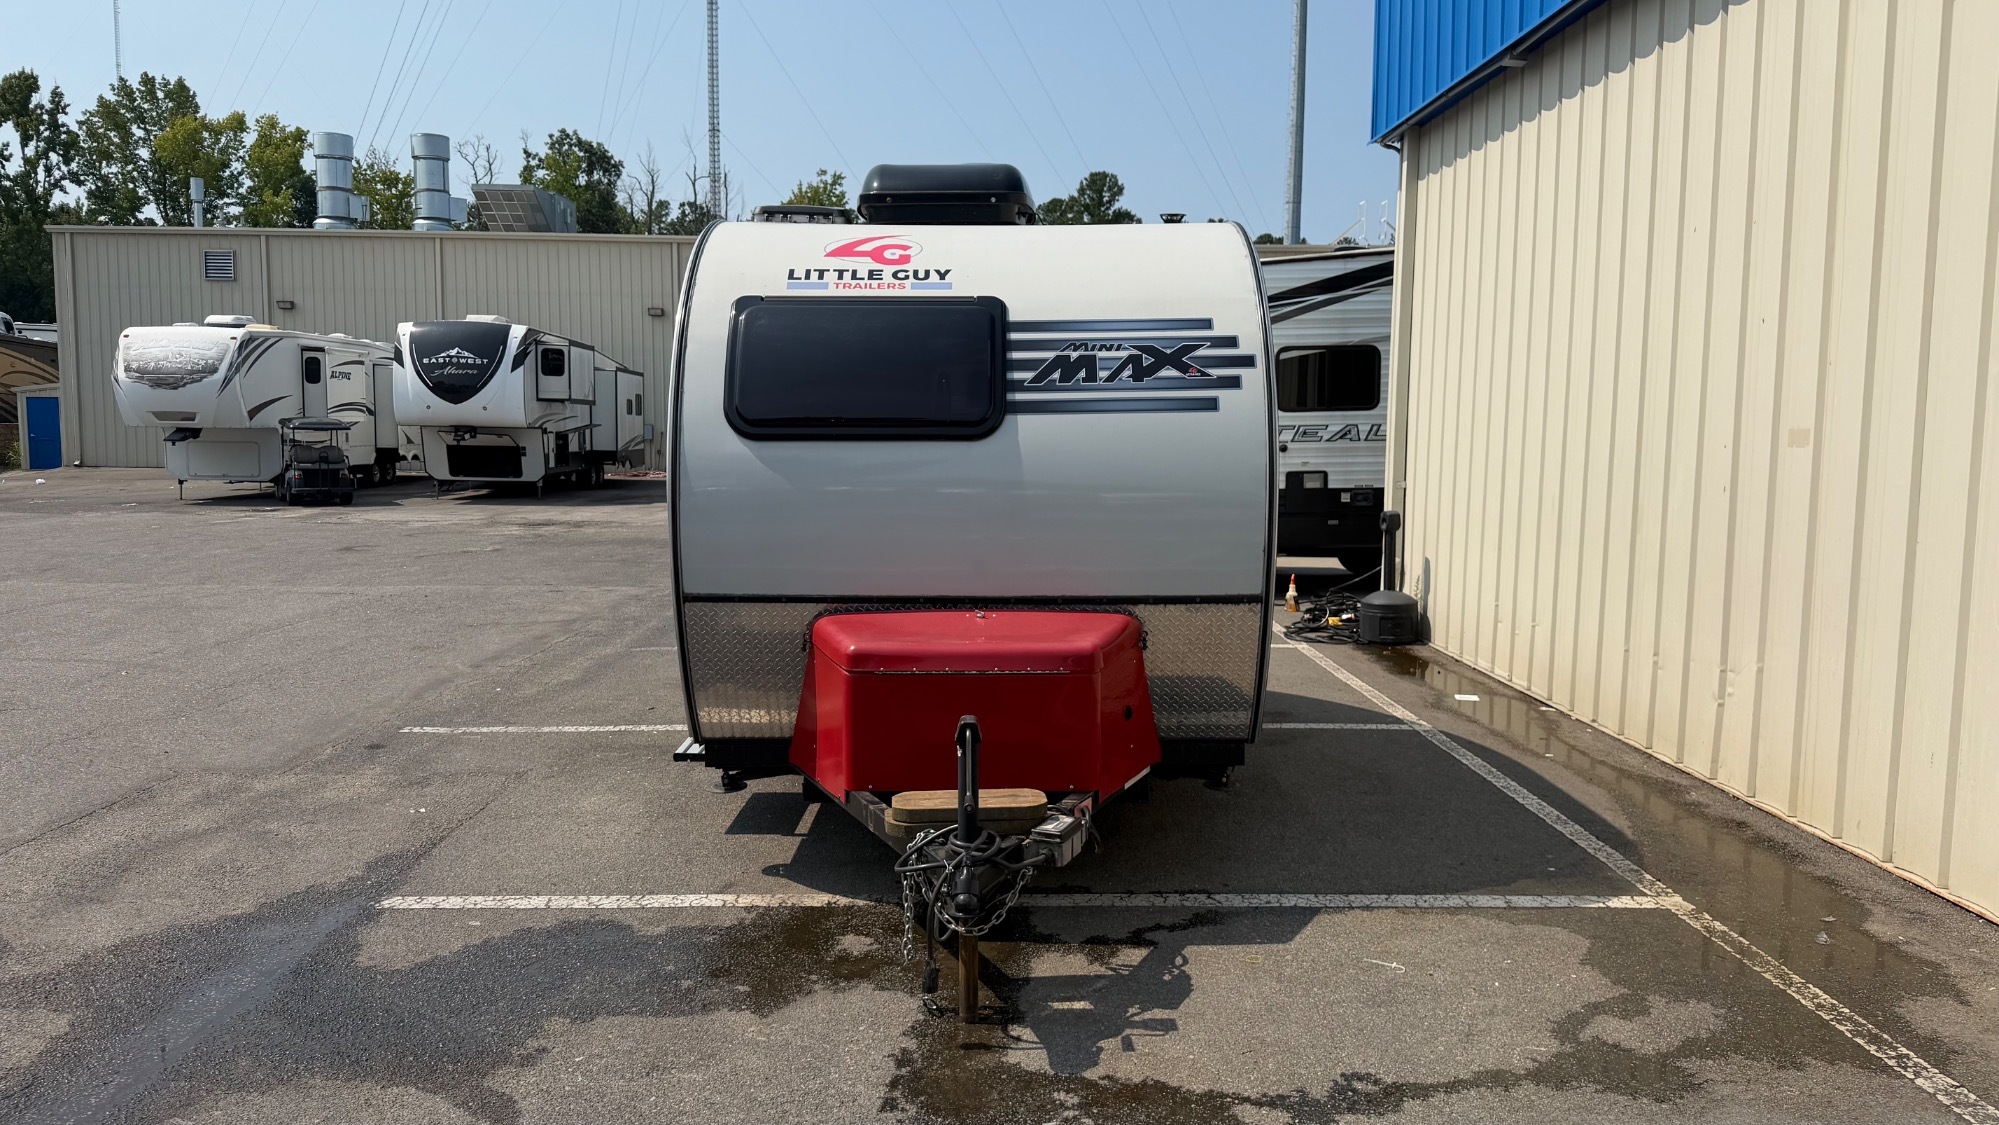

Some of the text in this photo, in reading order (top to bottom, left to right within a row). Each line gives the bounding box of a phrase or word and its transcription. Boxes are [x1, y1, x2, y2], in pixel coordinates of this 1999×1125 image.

[788, 269, 952, 281] LITTLE GUY
[834, 282, 906, 290] TRAILERS
[1058, 341, 1124, 352] MINI
[1024, 342, 1217, 385] MAX
[330, 371, 352, 380] ALPINE
